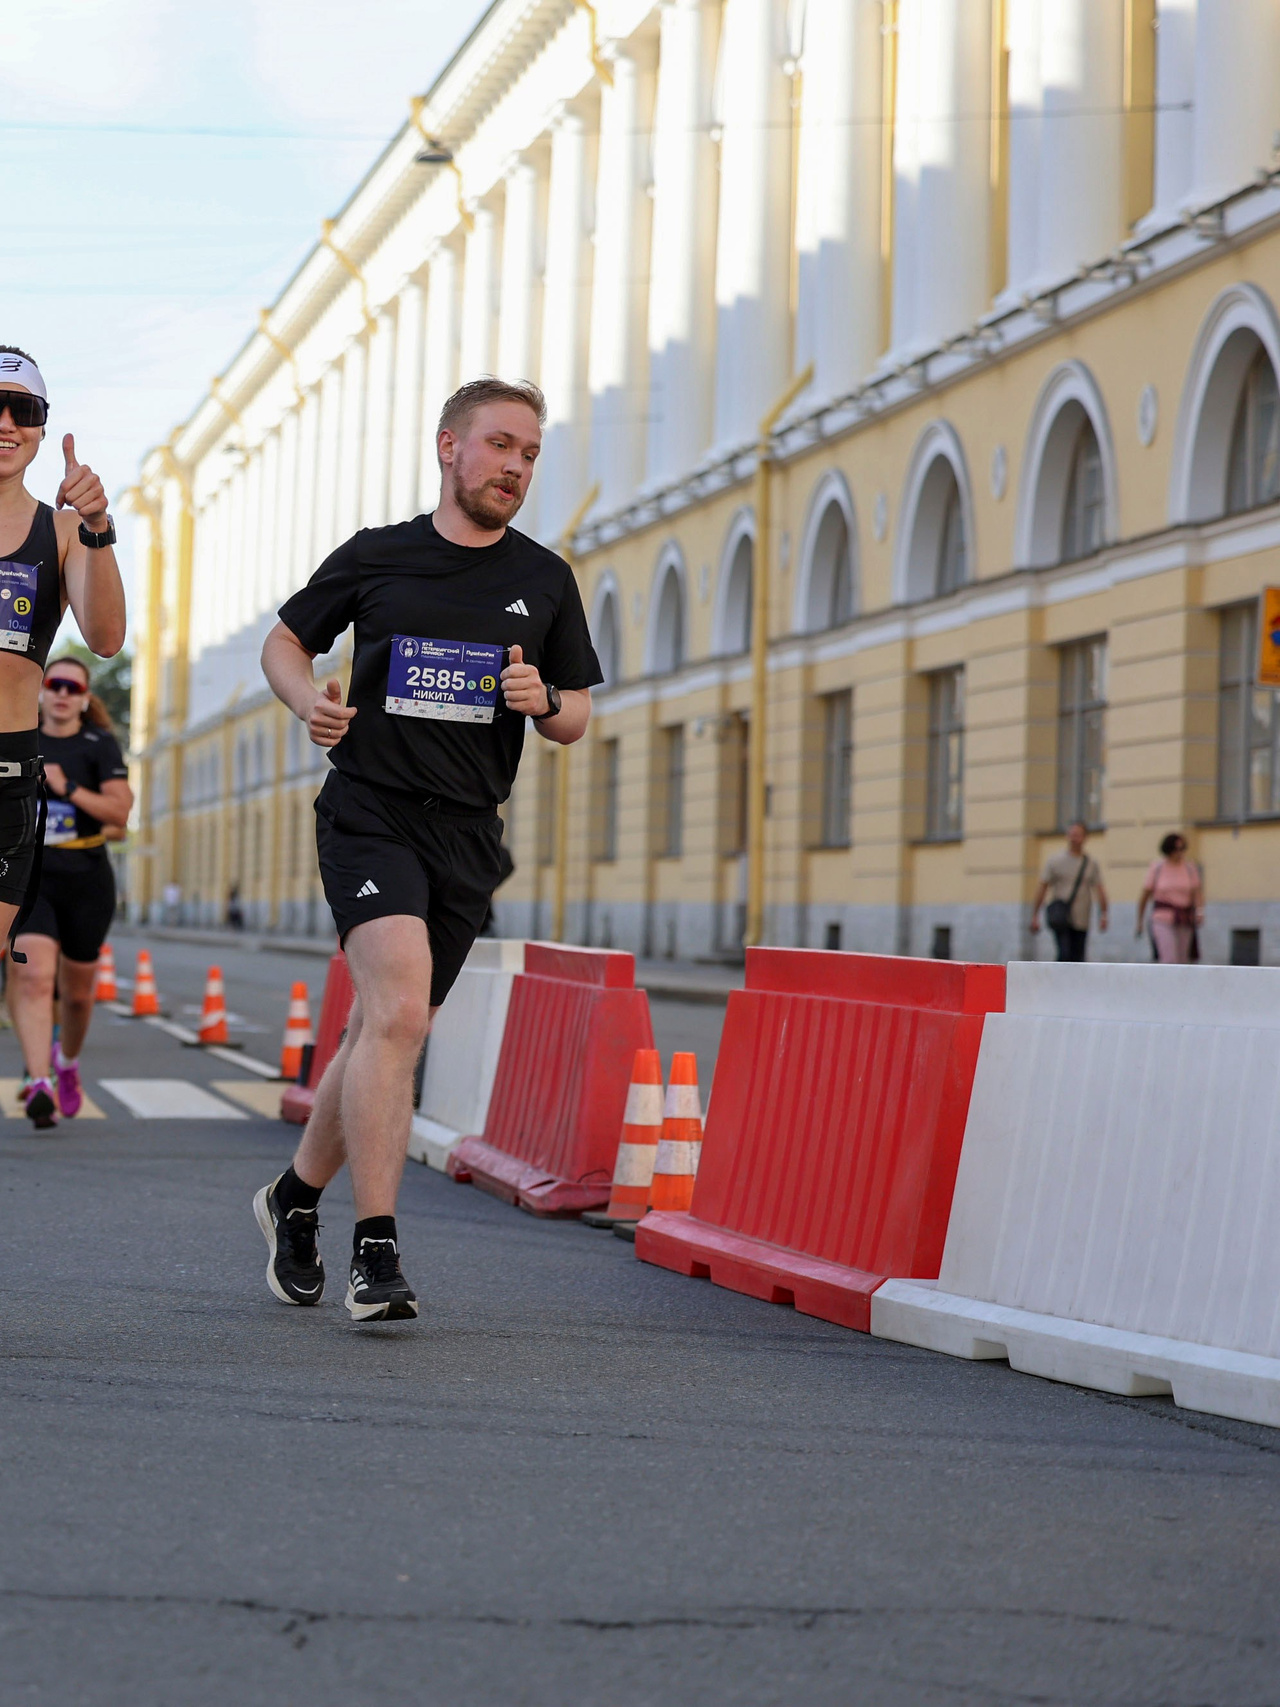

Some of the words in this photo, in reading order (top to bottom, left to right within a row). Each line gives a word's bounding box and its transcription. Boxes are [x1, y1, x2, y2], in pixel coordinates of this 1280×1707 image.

[18, 600, 28, 612] B
[406, 666, 466, 691] 2585
[483, 678, 492, 689] B
[412, 690, 455, 702] НИКИТА
